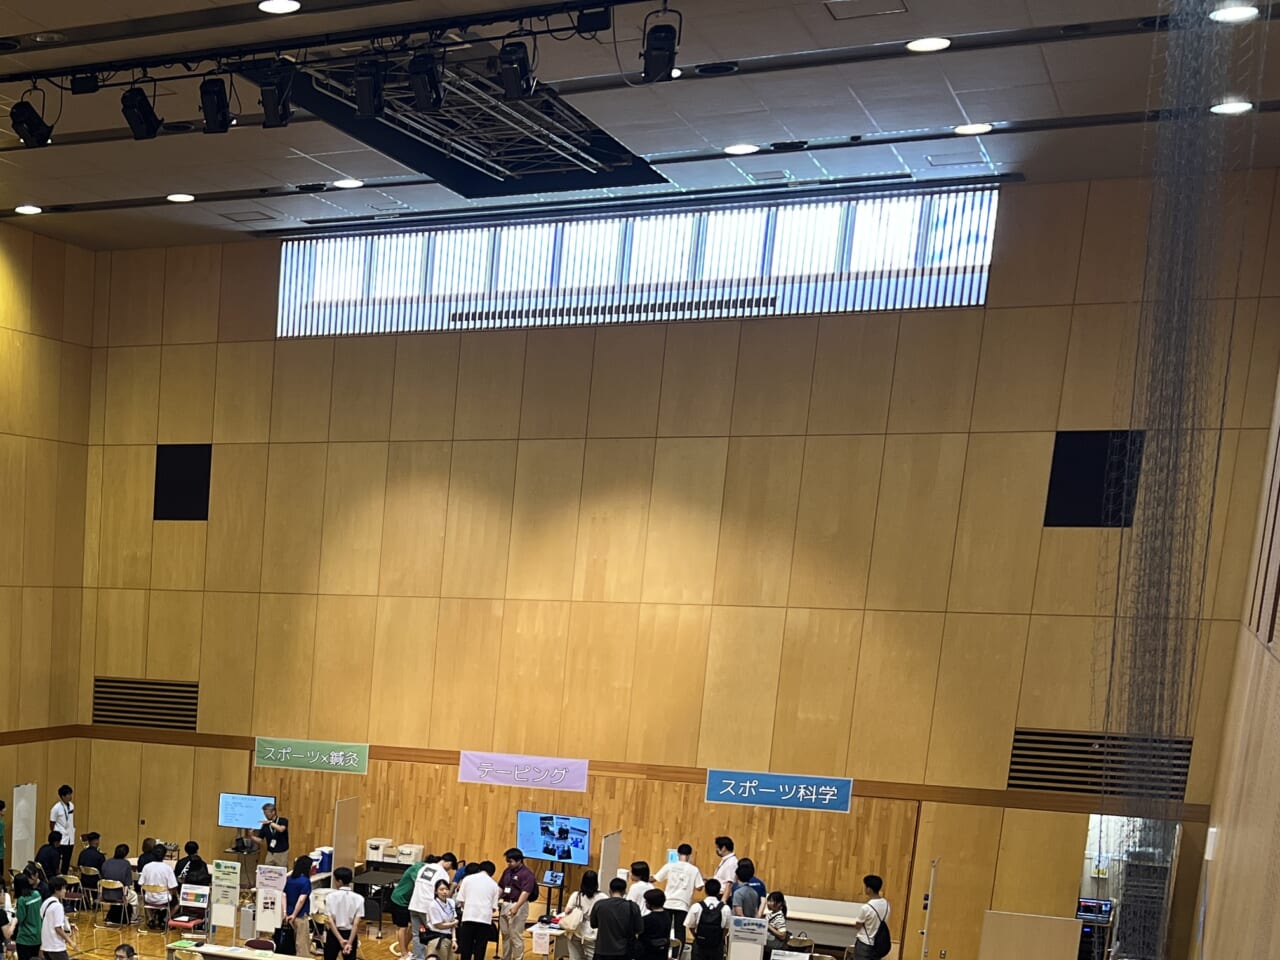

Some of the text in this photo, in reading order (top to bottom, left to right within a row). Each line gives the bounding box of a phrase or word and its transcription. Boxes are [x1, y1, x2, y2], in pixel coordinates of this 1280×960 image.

[263, 746, 360, 768] スポーツ×鍼灸
[476, 762, 570, 785] テーピング
[719, 779, 838, 804] スポーツ科学
